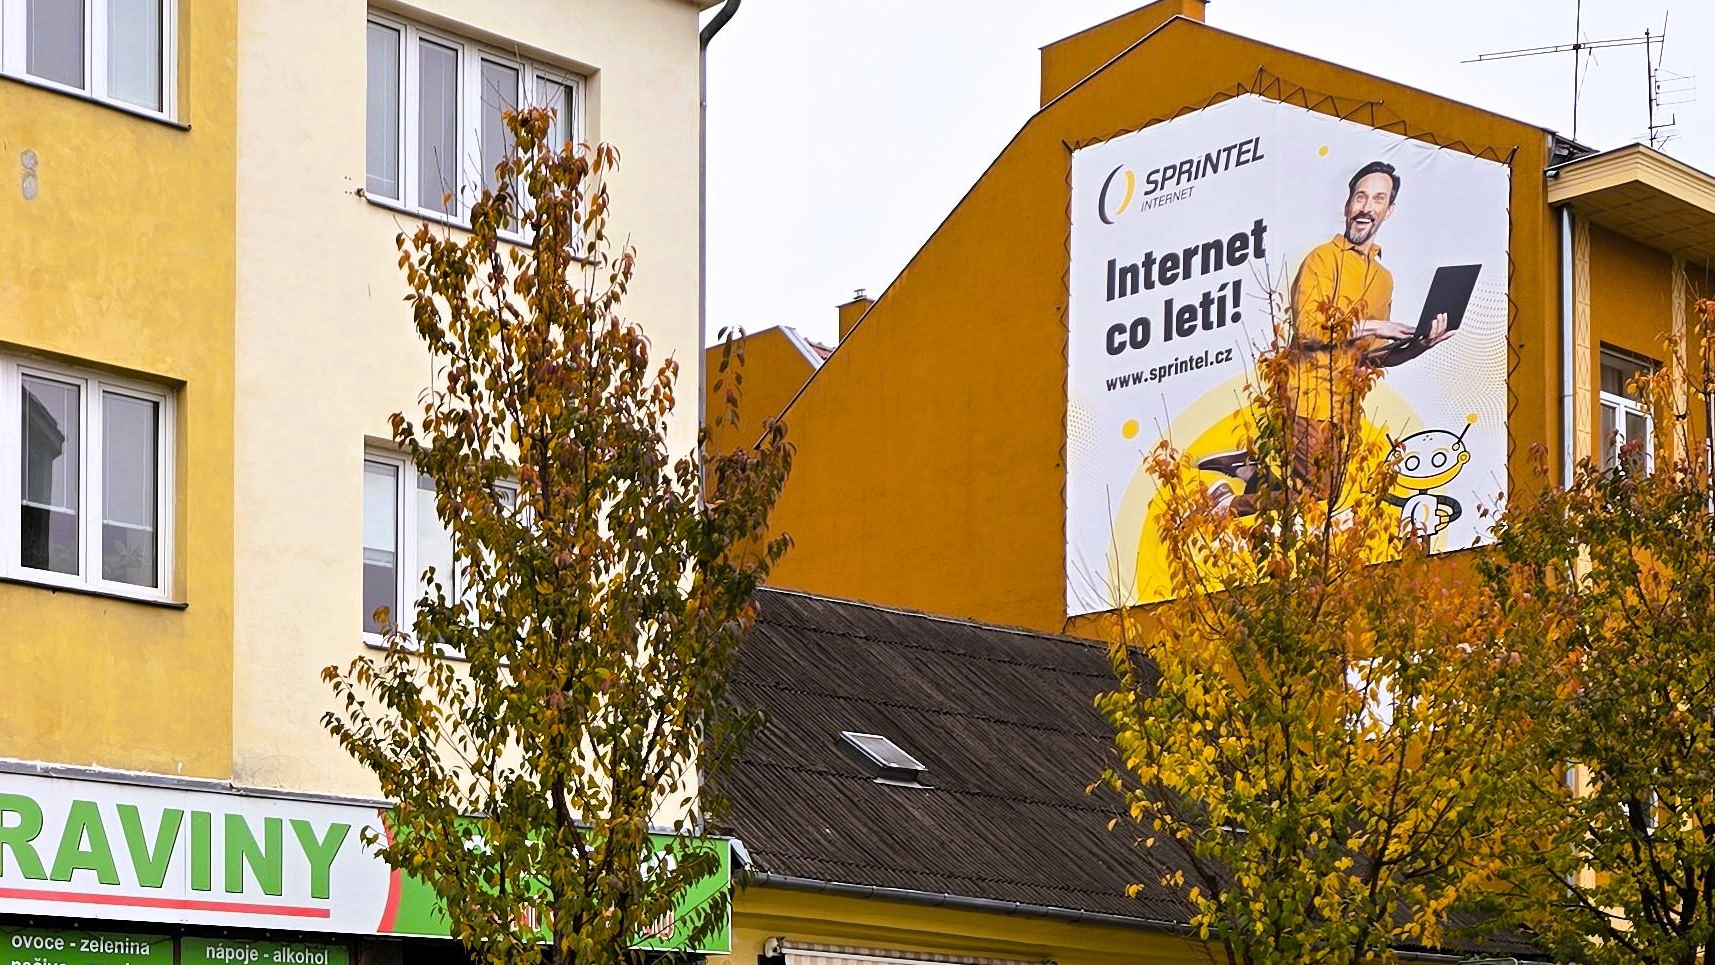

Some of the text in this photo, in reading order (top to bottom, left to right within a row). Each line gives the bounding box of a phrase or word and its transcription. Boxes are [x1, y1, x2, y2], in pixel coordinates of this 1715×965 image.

[1140, 186, 1195, 213] INTERNET
[1106, 218, 1268, 303] Internet
[1106, 279, 1243, 357] co letí!
[1106, 345, 1234, 392] www.sprintel.cz
[11, 936, 65, 951] ovoce
[80, 937, 150, 956] zelenina
[206, 943, 259, 963] nápoje
[273, 946, 328, 965] alkohol
